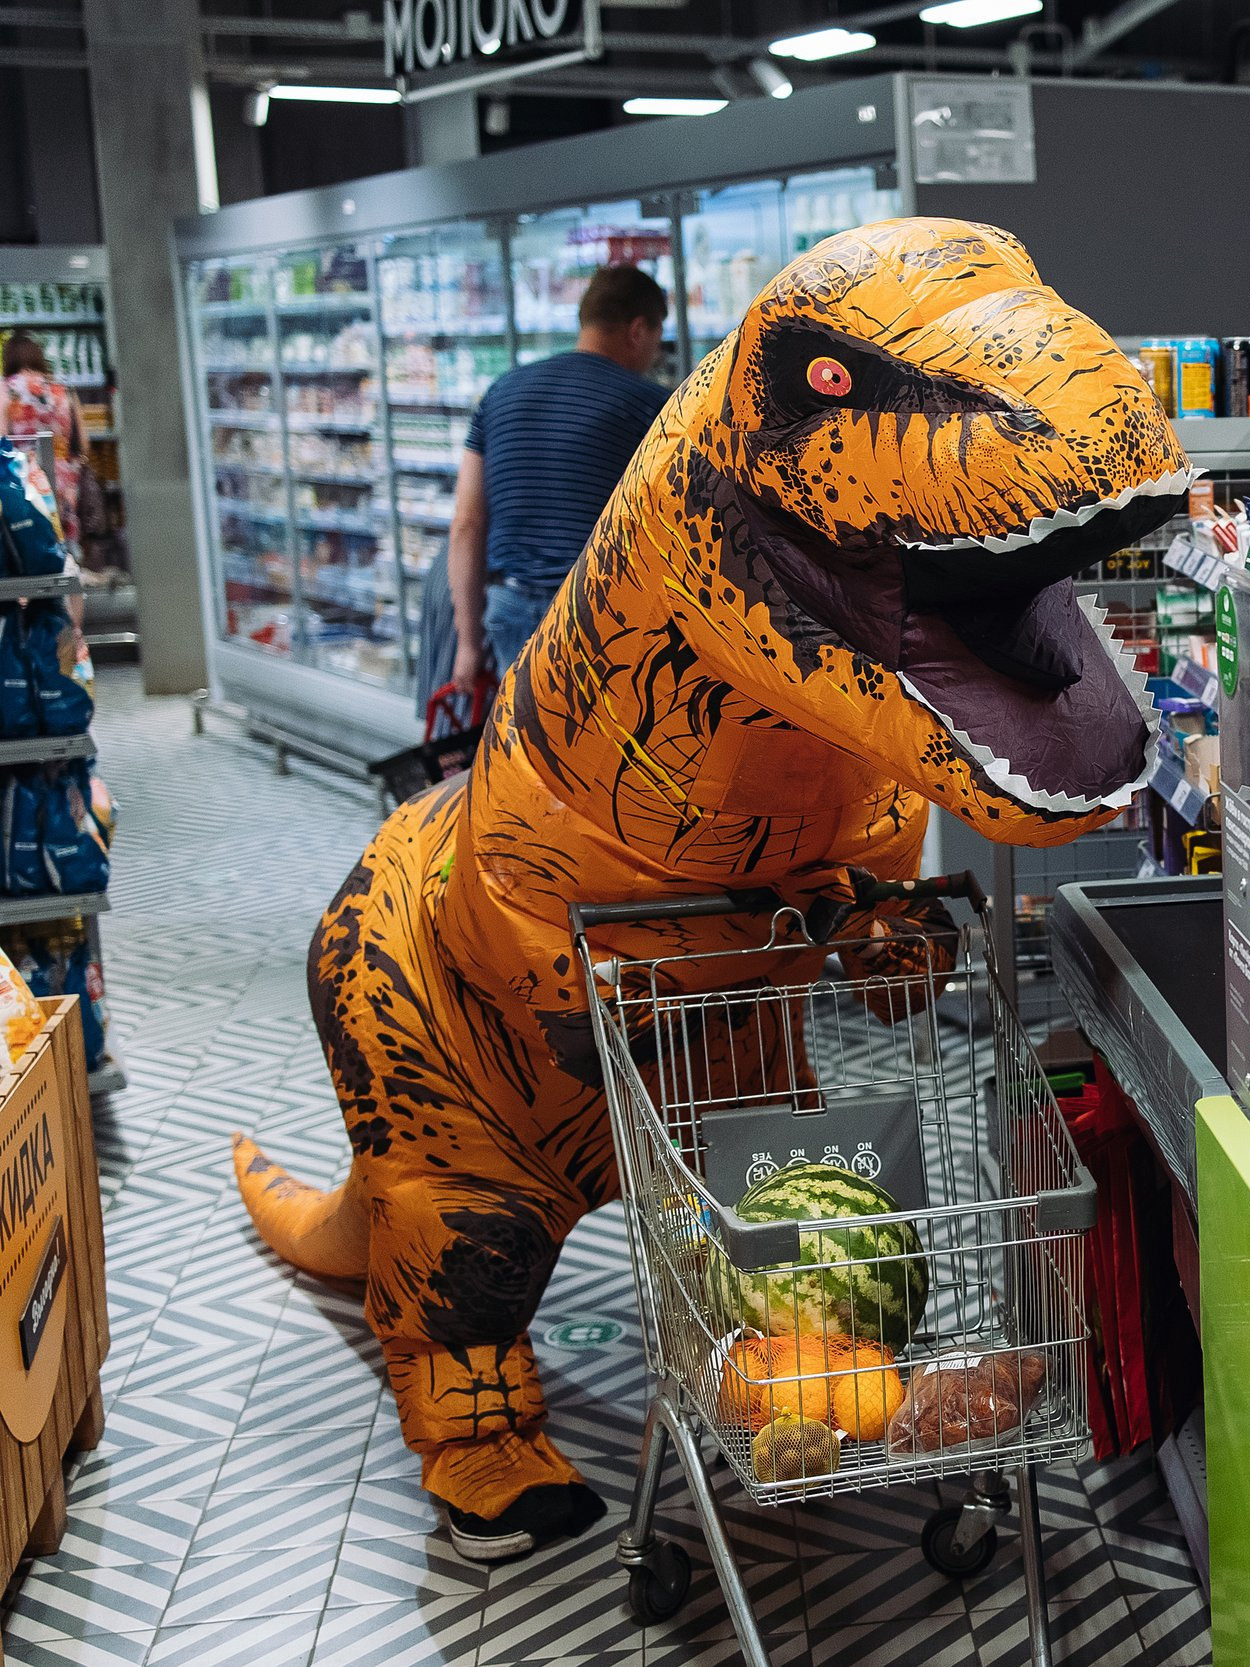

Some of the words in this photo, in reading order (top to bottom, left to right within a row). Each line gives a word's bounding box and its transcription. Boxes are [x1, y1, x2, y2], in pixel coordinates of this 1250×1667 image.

[824, 1145, 839, 1154] NO
[857, 1142, 872, 1151] NO
[752, 1152, 772, 1162] YES
[790, 1149, 805, 1158] NO
